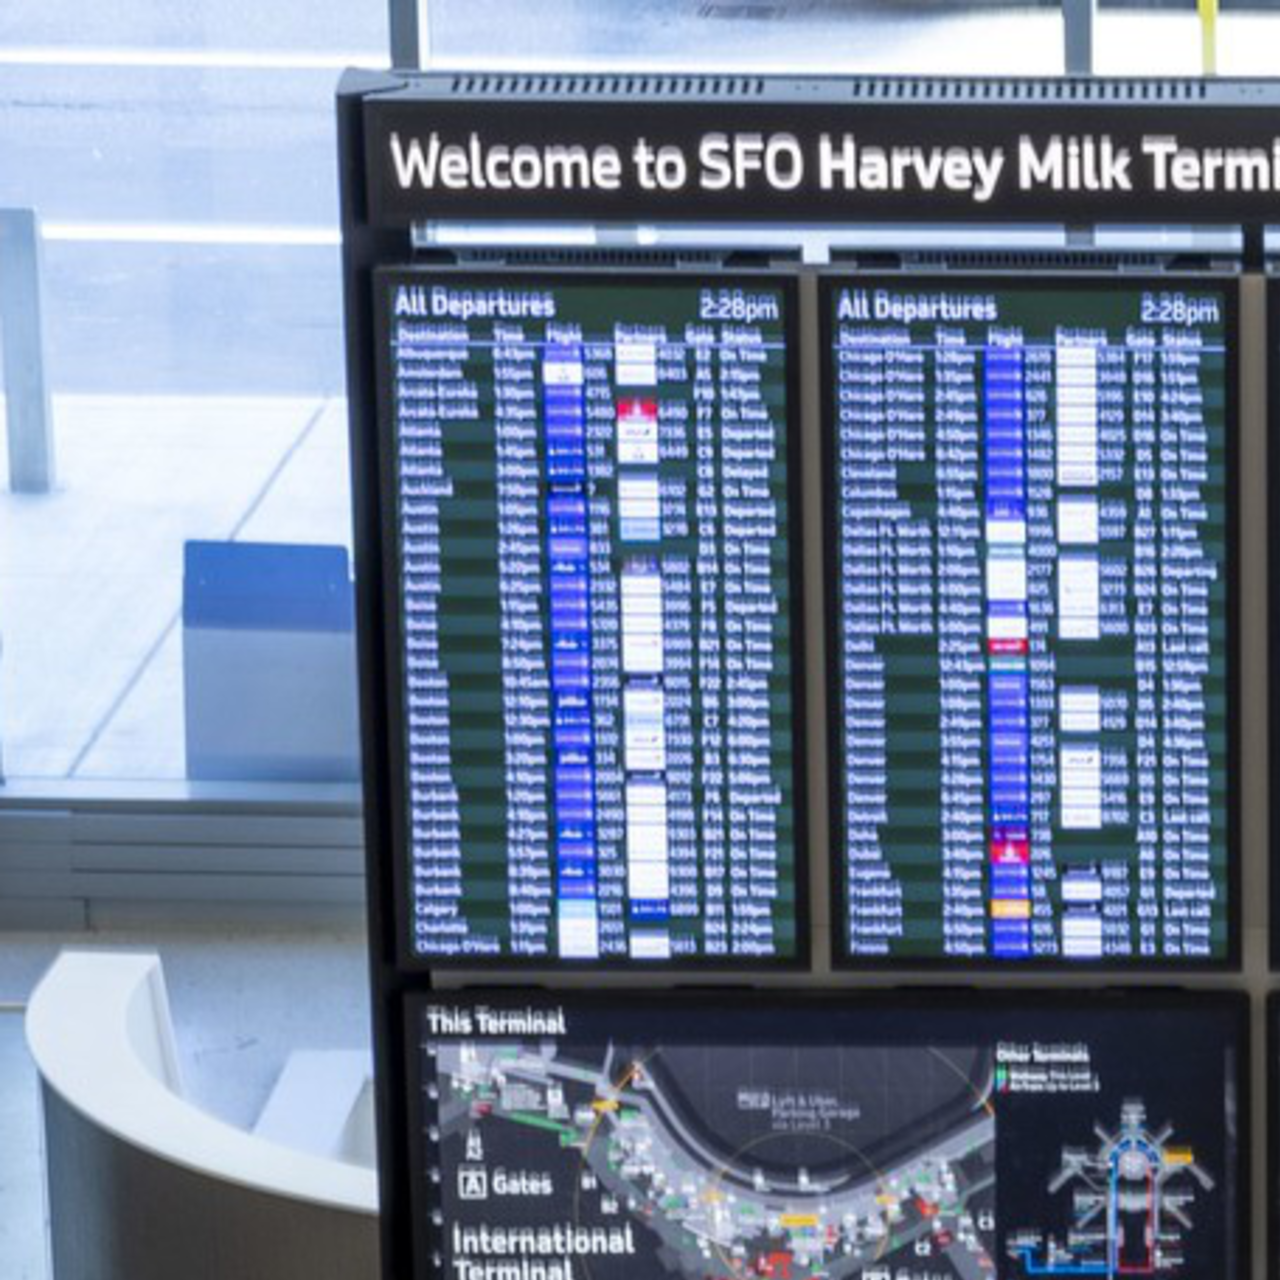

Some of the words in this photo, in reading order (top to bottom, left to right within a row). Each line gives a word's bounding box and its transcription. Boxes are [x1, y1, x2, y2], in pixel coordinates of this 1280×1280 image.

[390, 135, 620, 189] Welcome
[632, 139, 686, 189] to
[699, 136, 804, 190] SFO
[818, 137, 1003, 201] Harvey
[1018, 137, 1132, 190] Milk
[396, 290, 429, 316] All
[433, 290, 555, 320] Departures
[700, 293, 779, 321] 2:28pm
[838, 294, 869, 319] All
[875, 294, 997, 324] Departures
[1141, 296, 1219, 324] 2:28pm
[397, 326, 468, 341] Destination
[428, 1008, 473, 1034] This
[476, 1008, 566, 1034] Terminal
[493, 1171, 552, 1195] Gates
[453, 1224, 635, 1254] International
